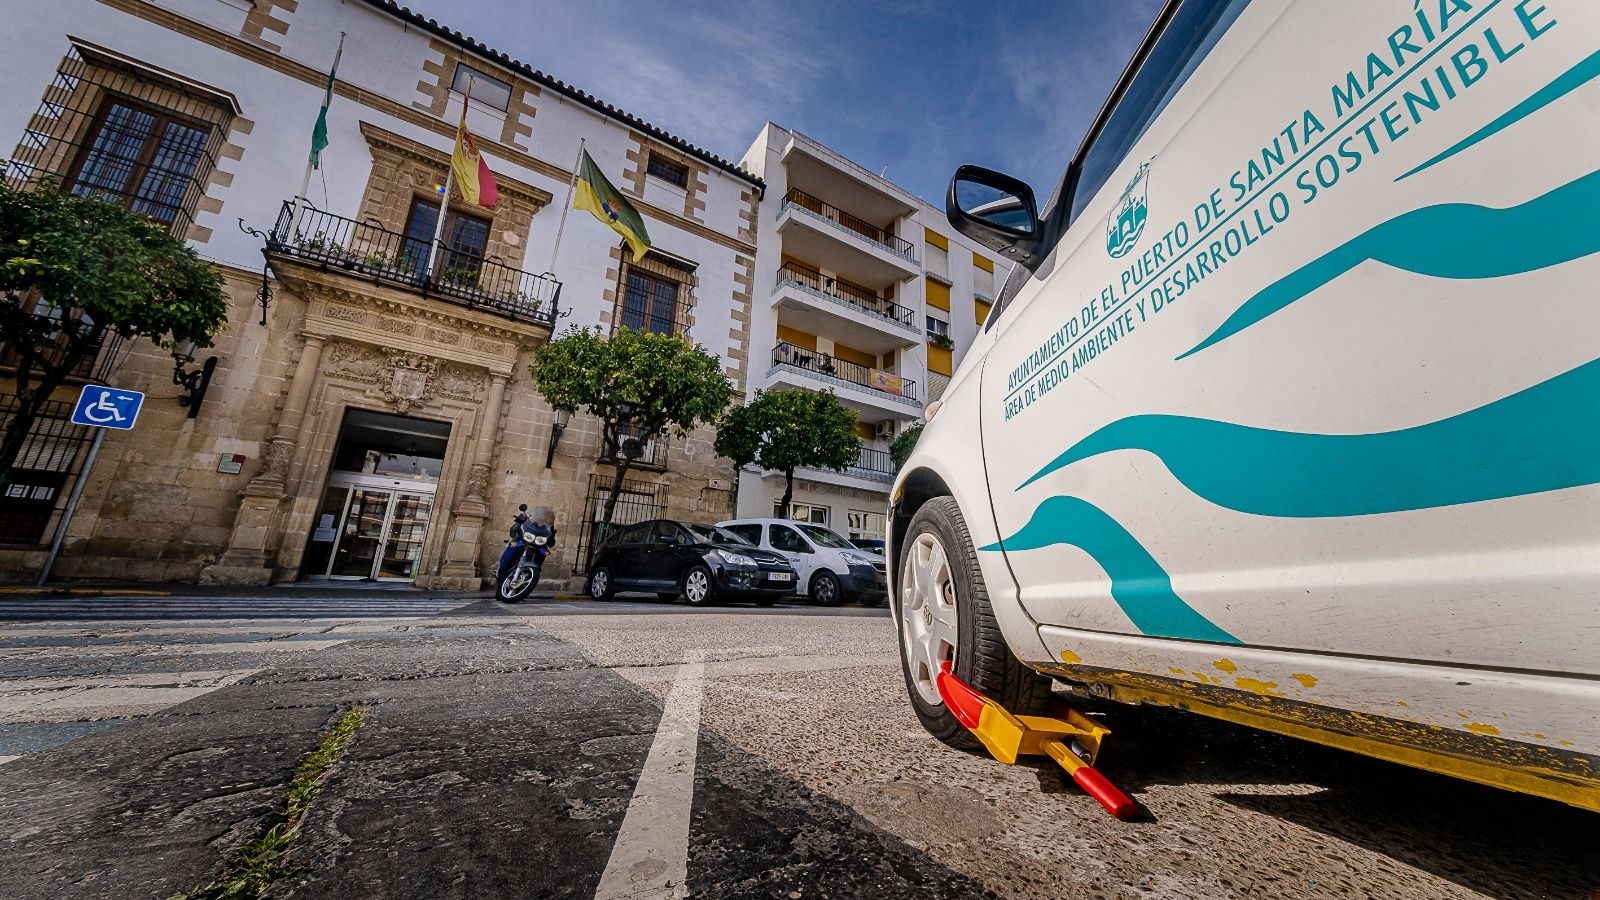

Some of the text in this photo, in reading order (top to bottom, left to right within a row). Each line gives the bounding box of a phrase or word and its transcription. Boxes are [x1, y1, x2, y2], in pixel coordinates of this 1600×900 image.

[1007, 0, 1473, 391] AYUNTAMIENTO DE EL PUERTO DE SANTA MARÍA
[1024, 384, 1037, 407] DE
[1038, 360, 1069, 397] MEDIO
[1072, 308, 1135, 373] AMBIENTE
[1137, 298, 1148, 323] Y
[1152, 191, 1291, 313] DESARROLLO
[1296, 0, 1558, 204] SOSTENIBLE
